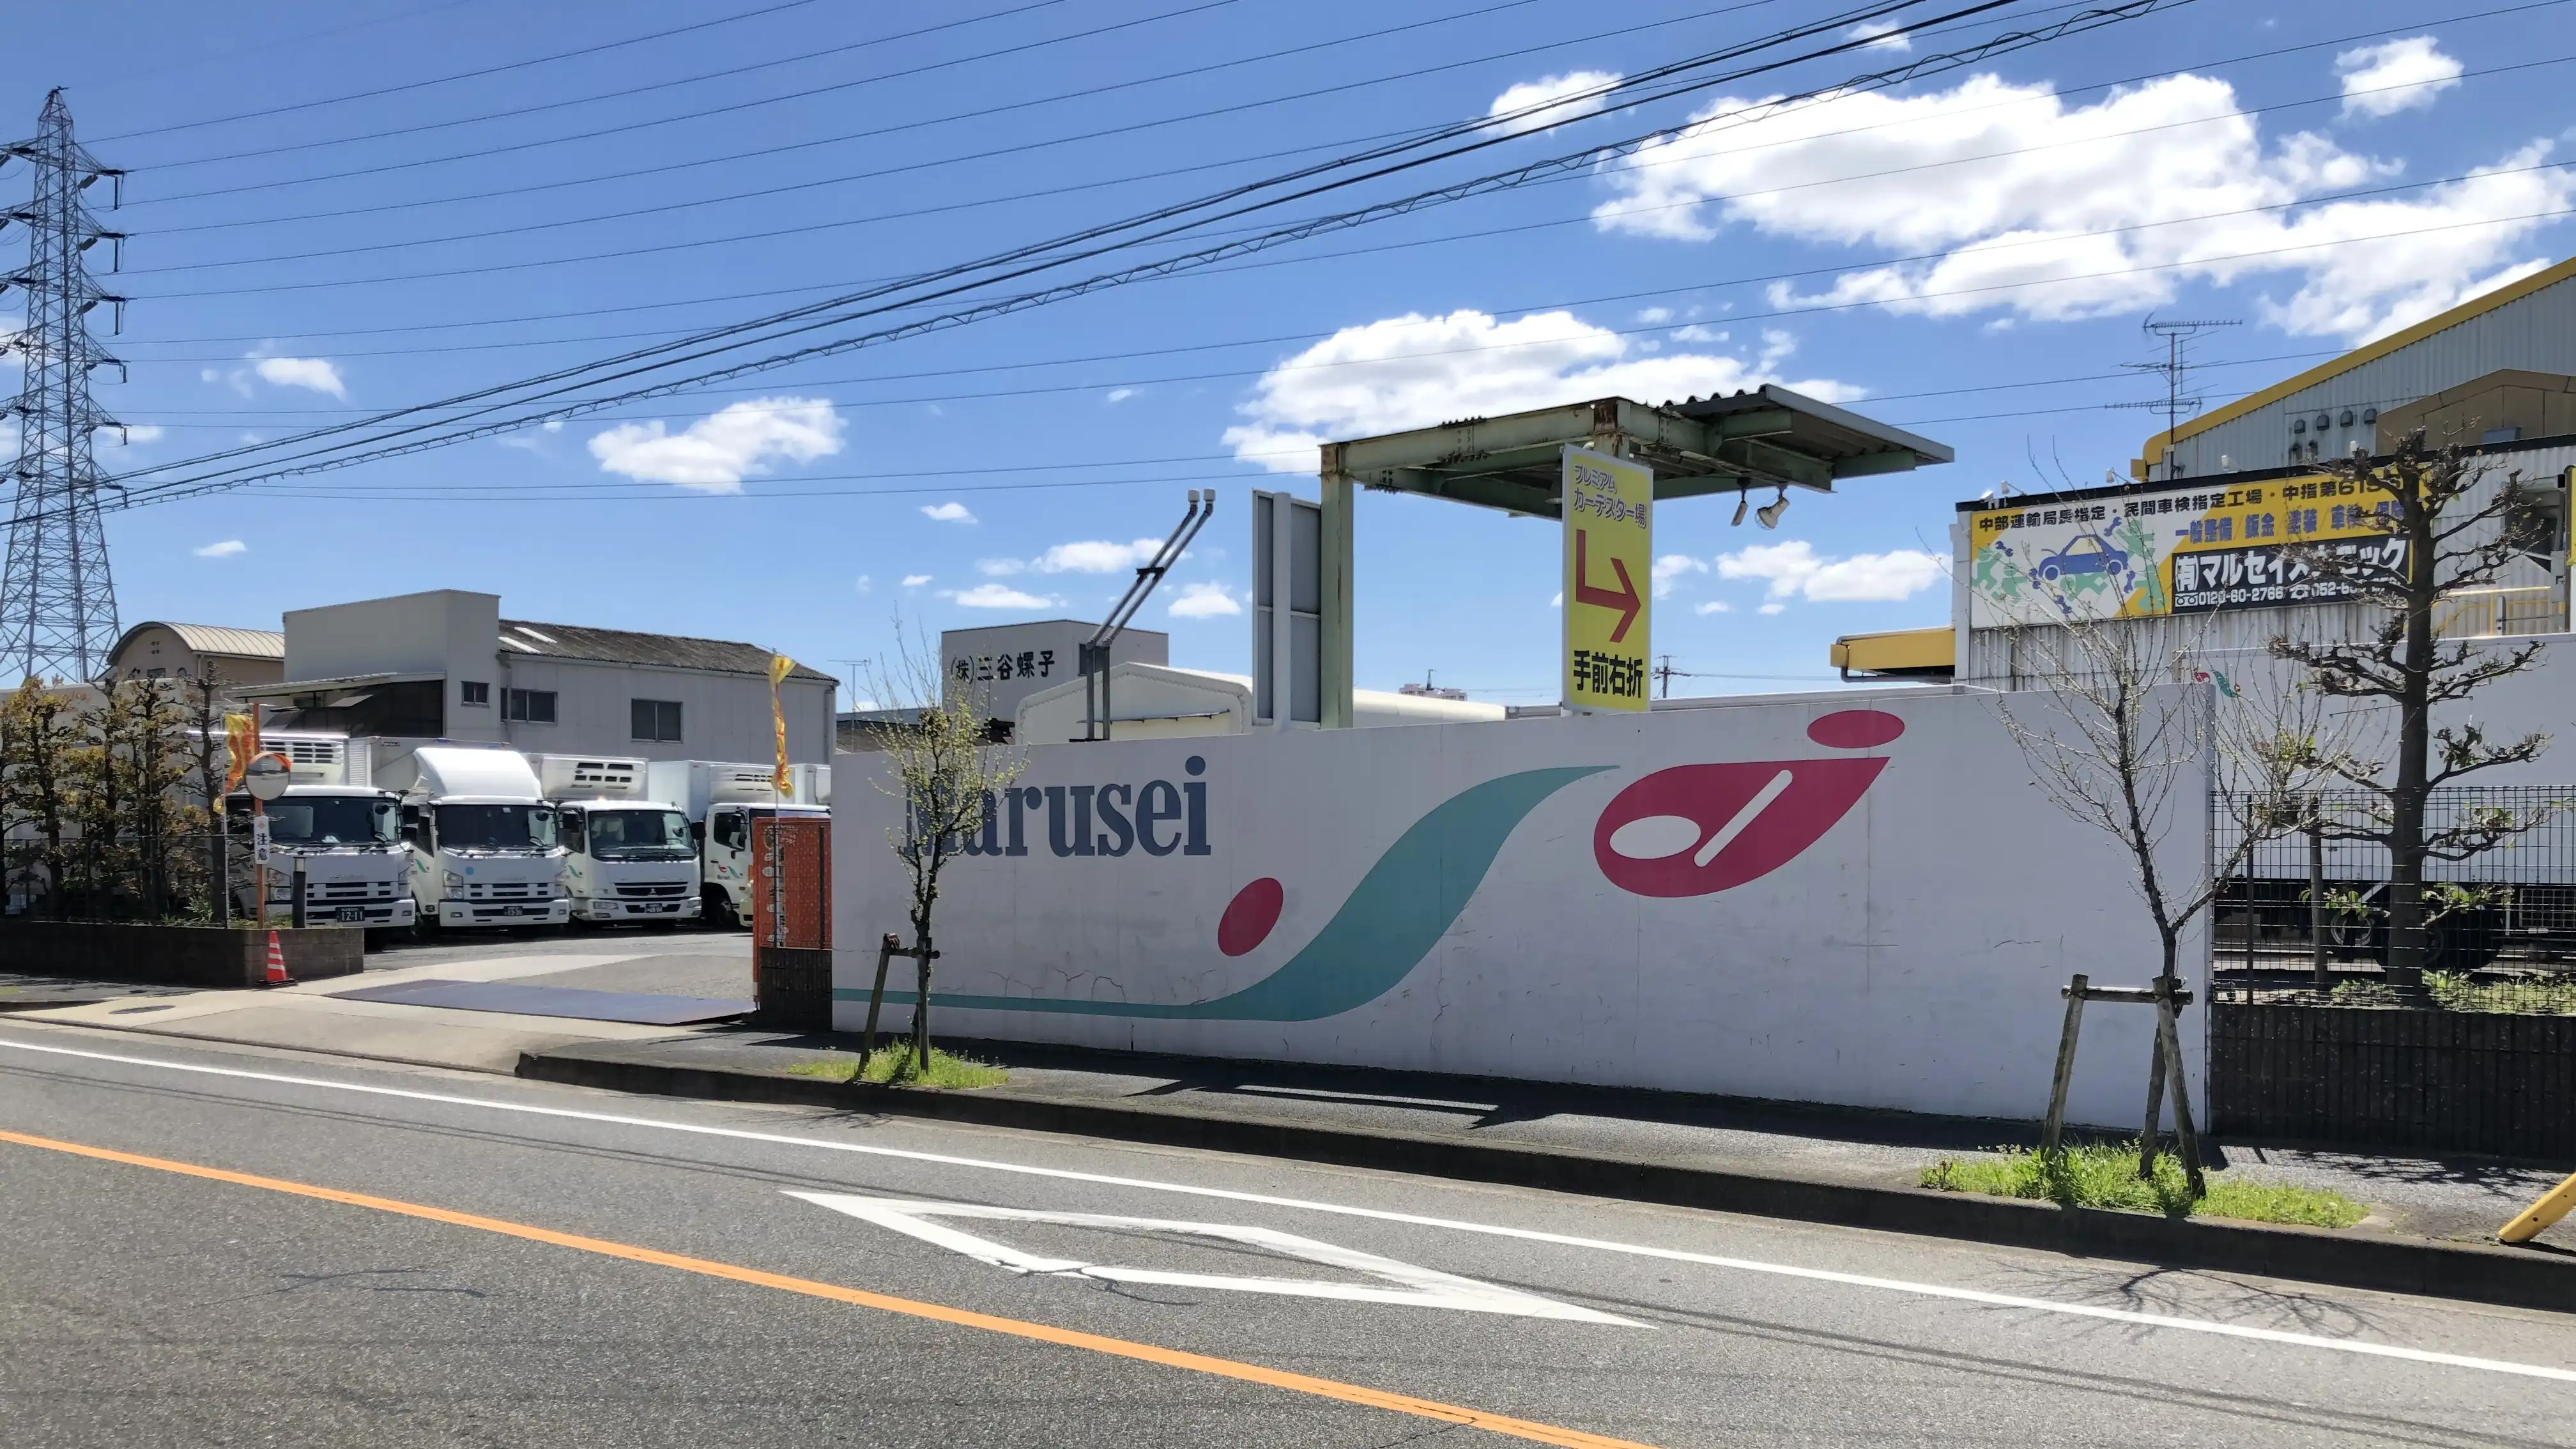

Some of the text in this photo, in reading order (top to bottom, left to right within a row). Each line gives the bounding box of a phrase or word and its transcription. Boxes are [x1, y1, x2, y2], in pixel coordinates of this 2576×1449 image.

[1574, 487, 1646, 528] カーテスター場
[1573, 649, 1643, 699] 手前右折
